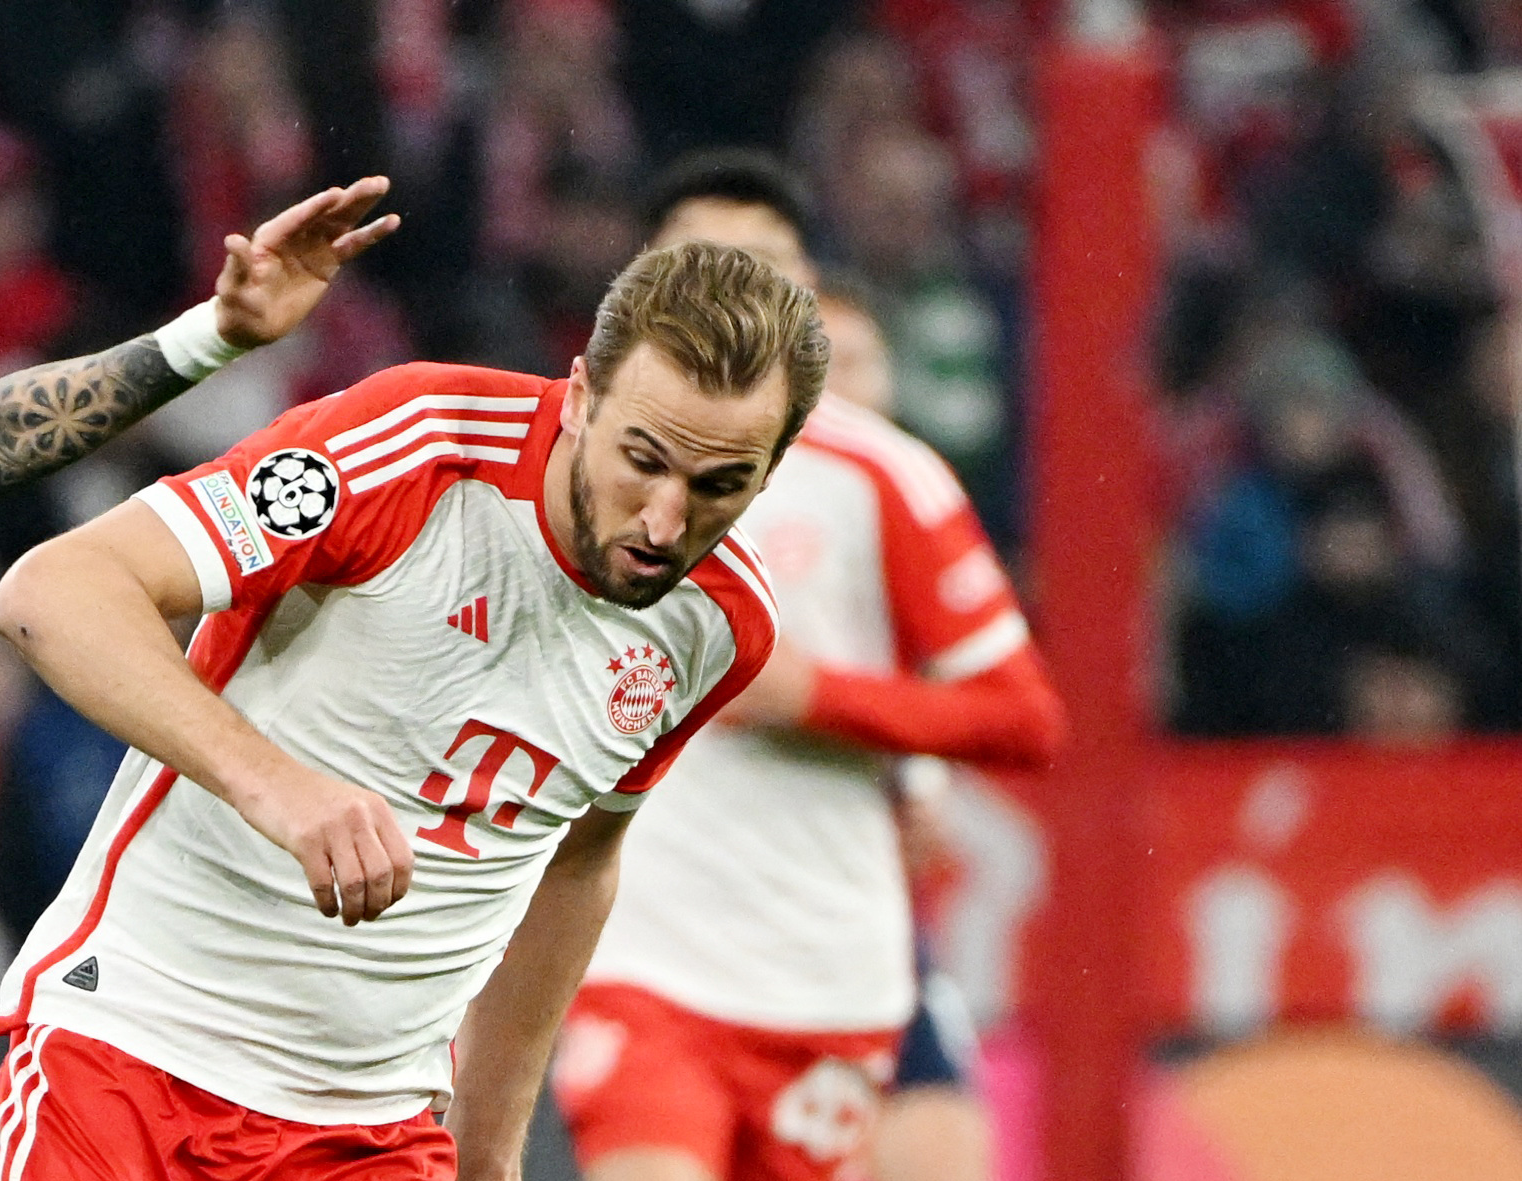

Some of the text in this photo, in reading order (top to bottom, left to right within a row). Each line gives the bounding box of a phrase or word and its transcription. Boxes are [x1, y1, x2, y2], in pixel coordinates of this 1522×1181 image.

[278, 476, 308, 508] 6
[206, 475, 261, 570] OUNDATION
[620, 670, 663, 700] FC BAYERN
